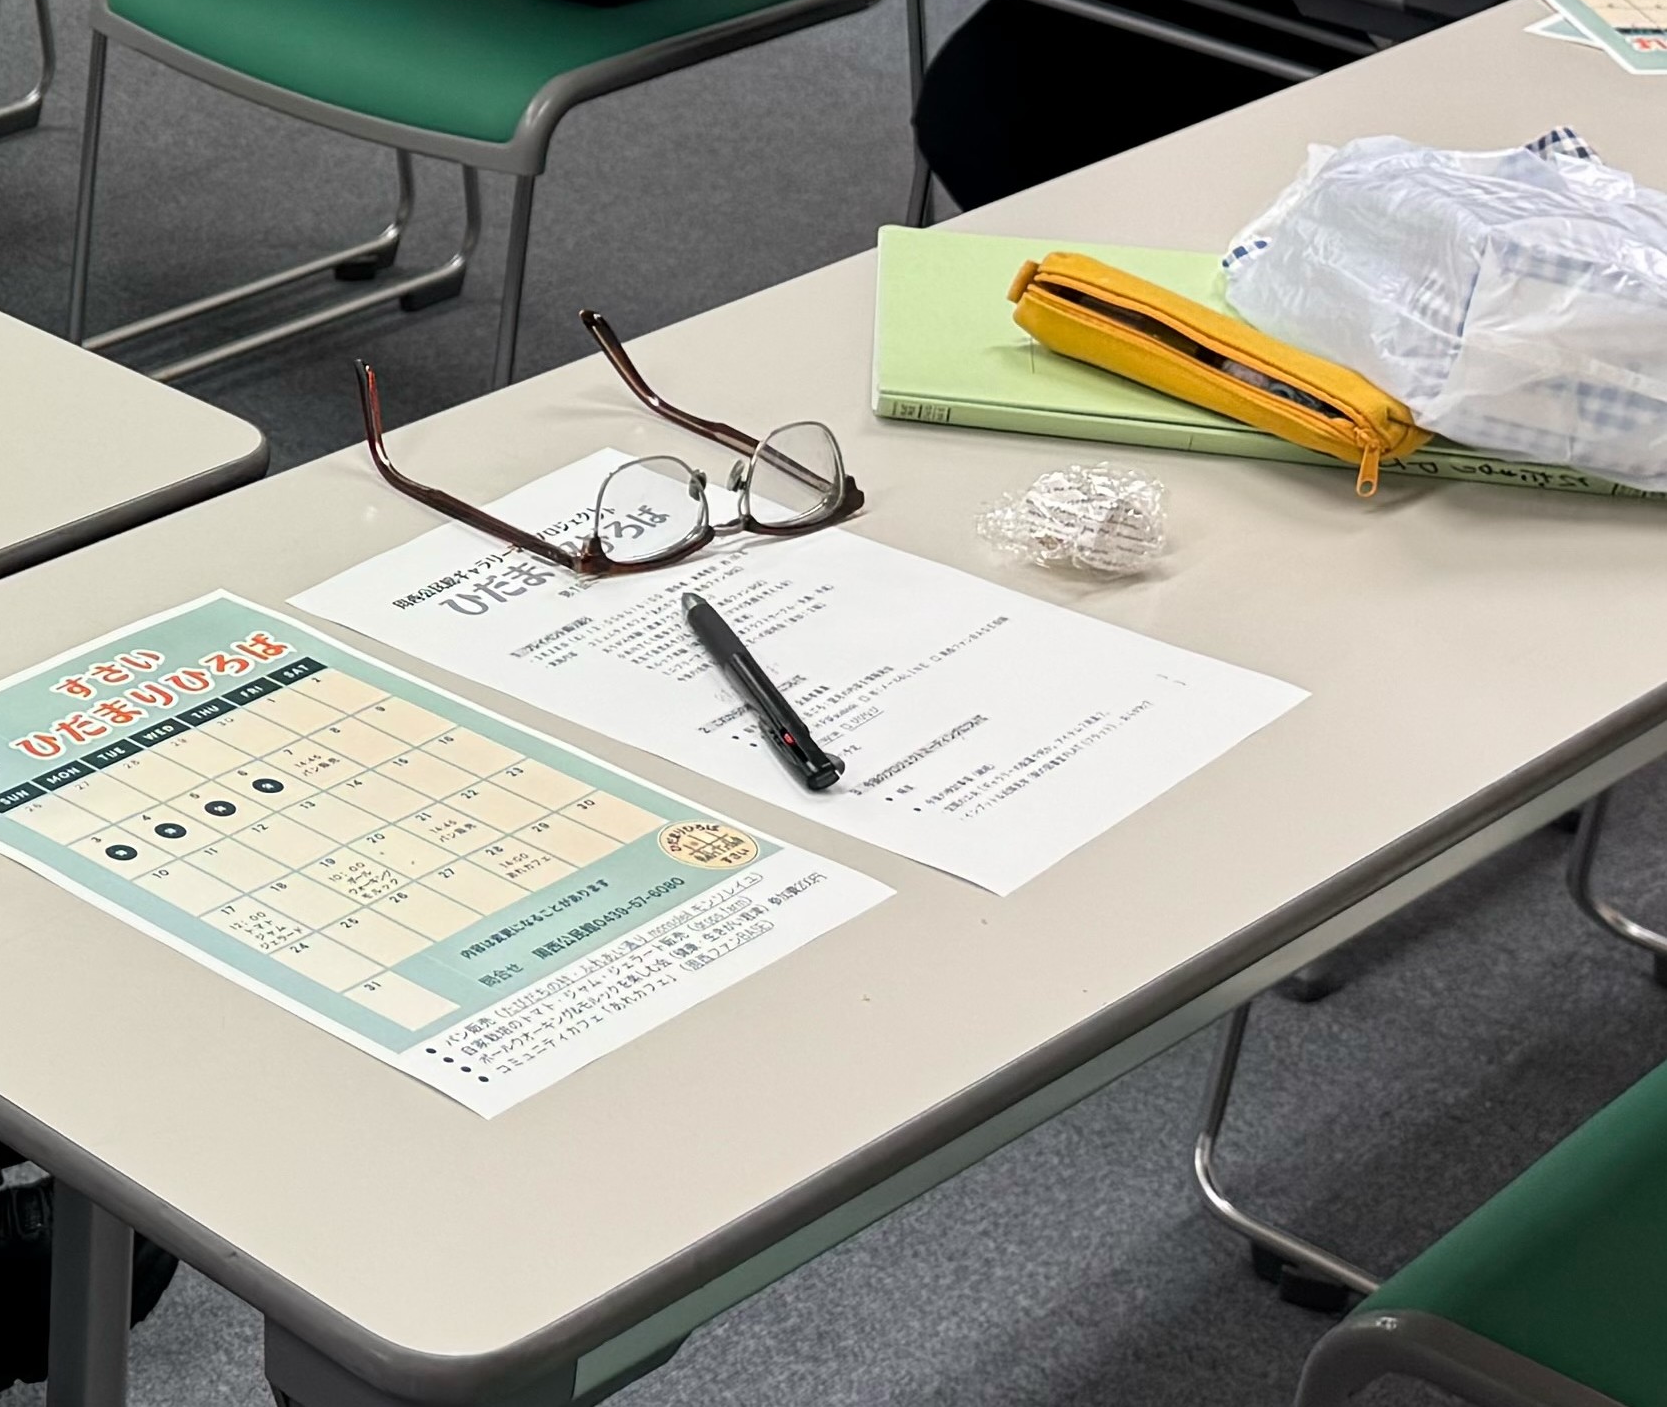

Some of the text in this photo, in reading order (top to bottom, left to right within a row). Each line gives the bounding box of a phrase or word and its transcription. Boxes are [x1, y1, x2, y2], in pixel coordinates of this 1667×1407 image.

[0, 664, 308, 804] SUN MON TUE WED THU FRI SAT
[15, 632, 289, 758] ひだまりひろば
[56, 650, 164, 699] すさい
[152, 869, 169, 878] 10
[203, 847, 217, 855] 11
[251, 823, 268, 832] 12
[346, 779, 362, 787] 14
[392, 758, 408, 766] 15
[438, 736, 454, 744] 16
[220, 767, 523, 914] 17 18 19 20 21 22 23
[289, 799, 595, 953] 24 25 26 27 28 29 30
[456, 876, 614, 960] 内容は変更になることがあります
[363, 981, 381, 990] 31
[476, 960, 527, 988] 問合せ
